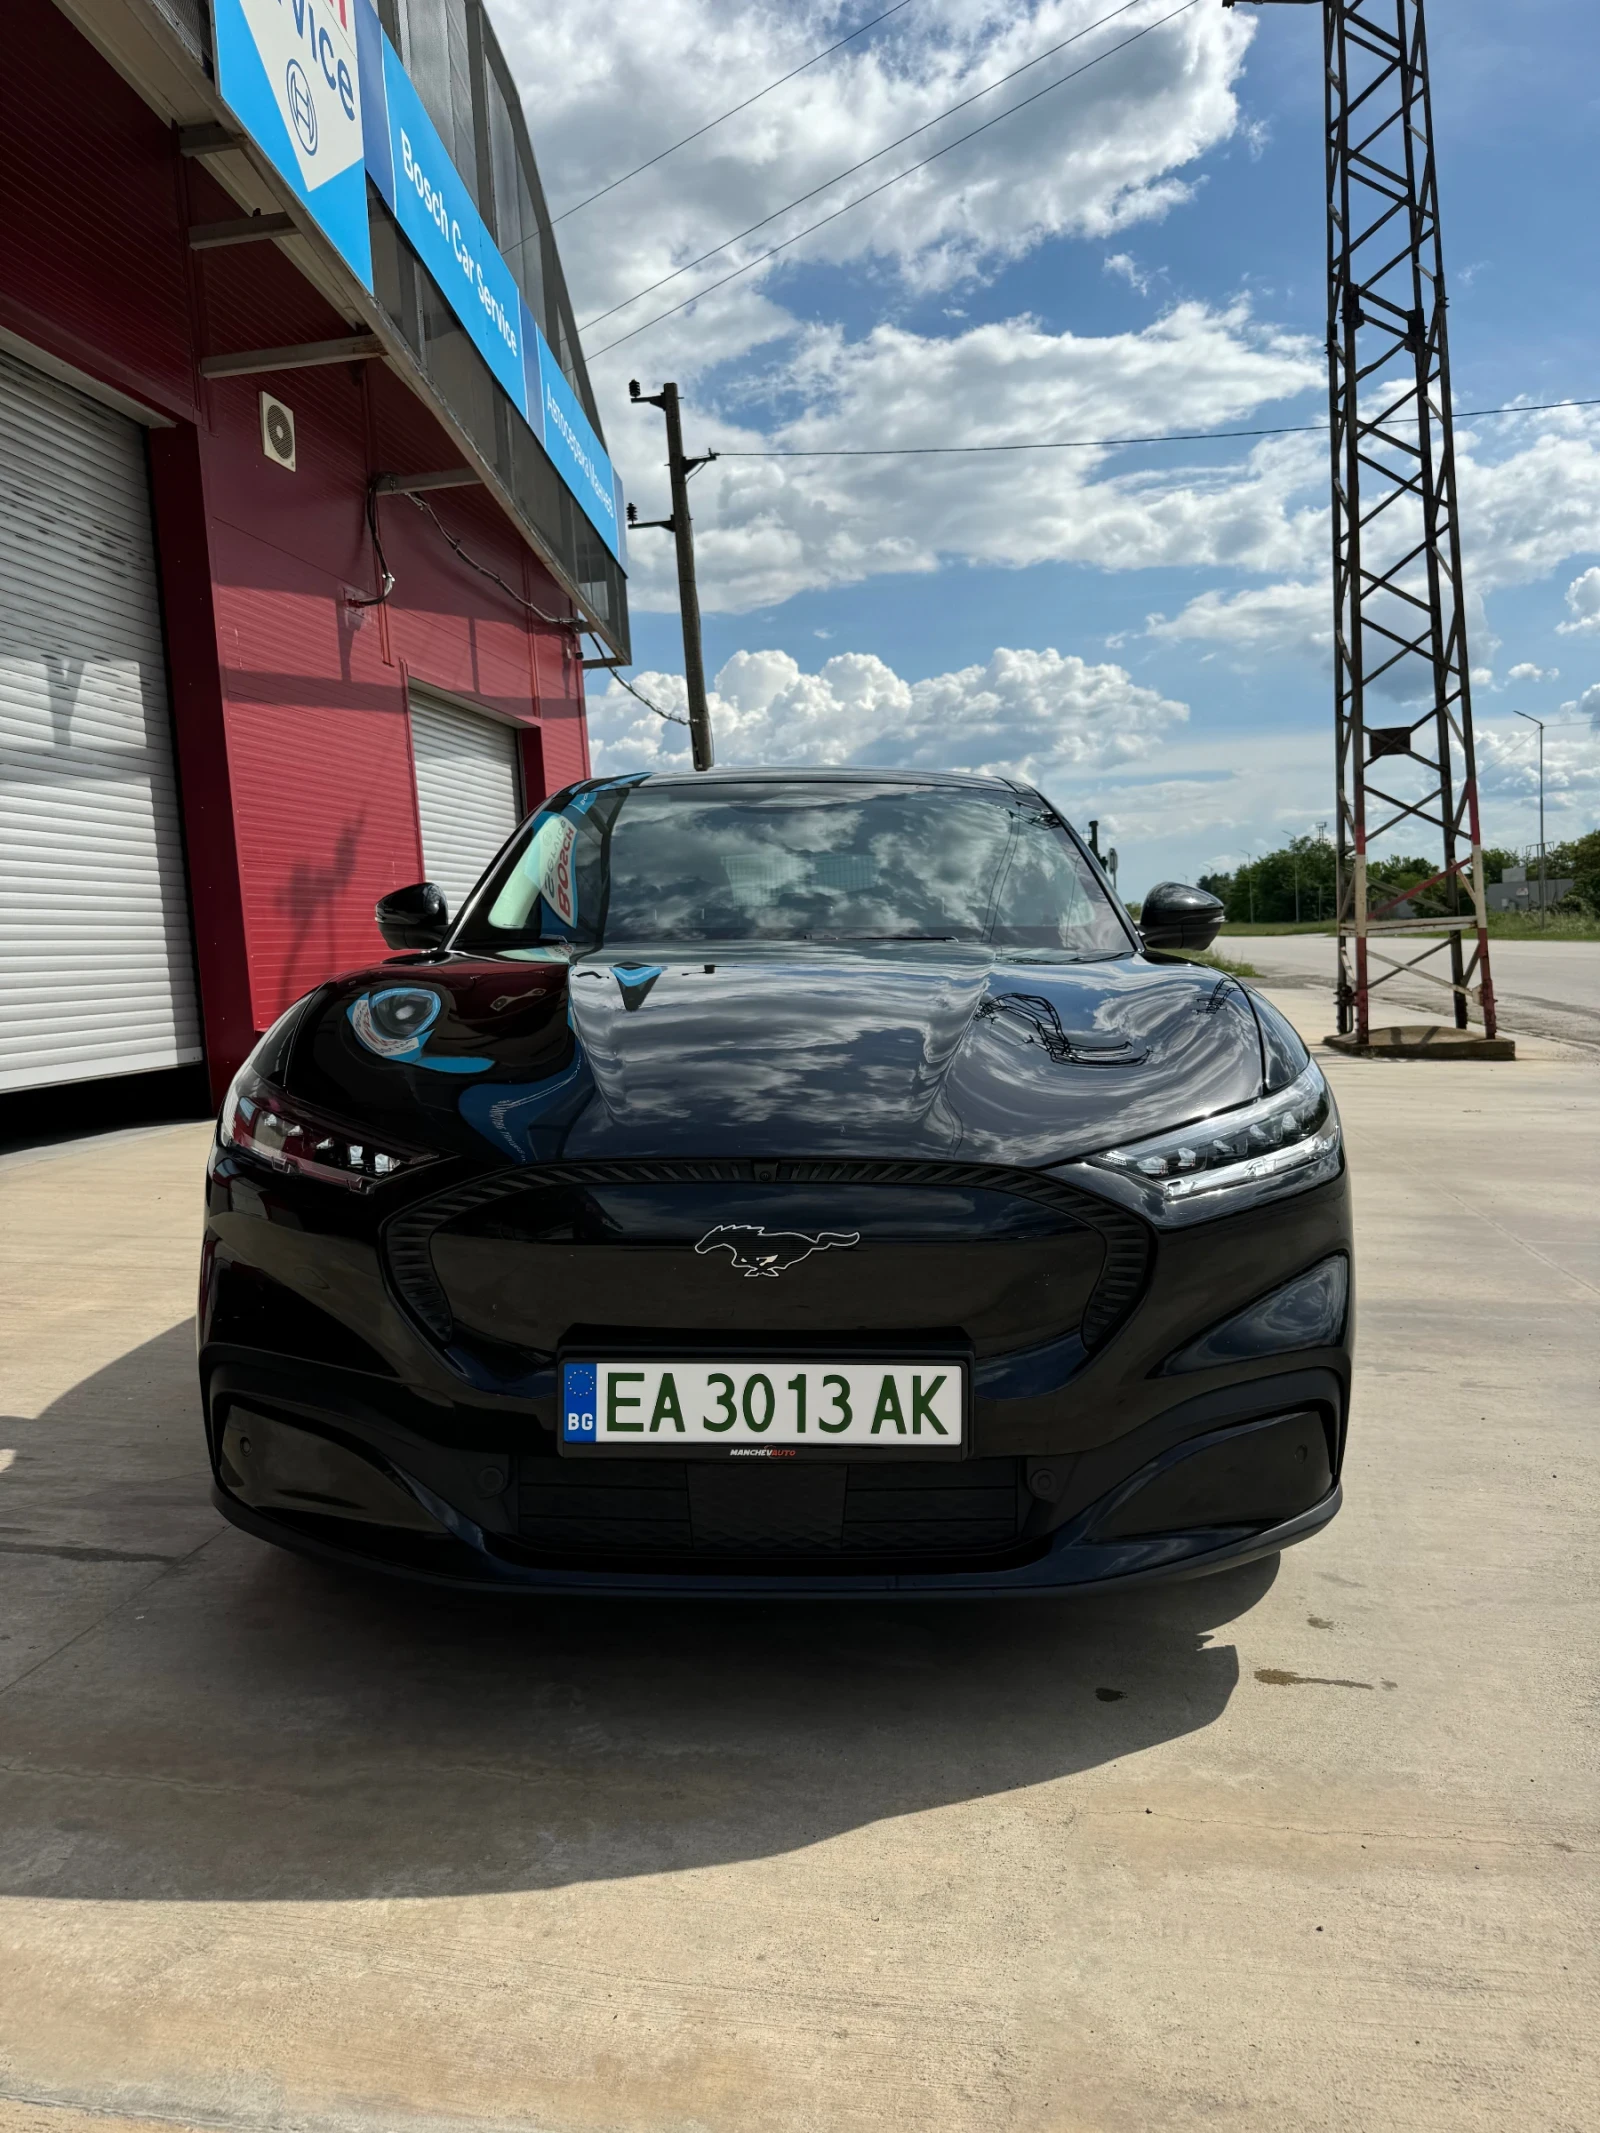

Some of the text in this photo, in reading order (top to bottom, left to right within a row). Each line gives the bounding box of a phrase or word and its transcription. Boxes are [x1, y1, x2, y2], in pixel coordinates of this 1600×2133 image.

[278, 0, 355, 121] vice
[401, 127, 517, 358] Bosch Car Service
[567, 1412, 593, 1431] BG
[606, 1372, 949, 1435] EA 3013 AK
